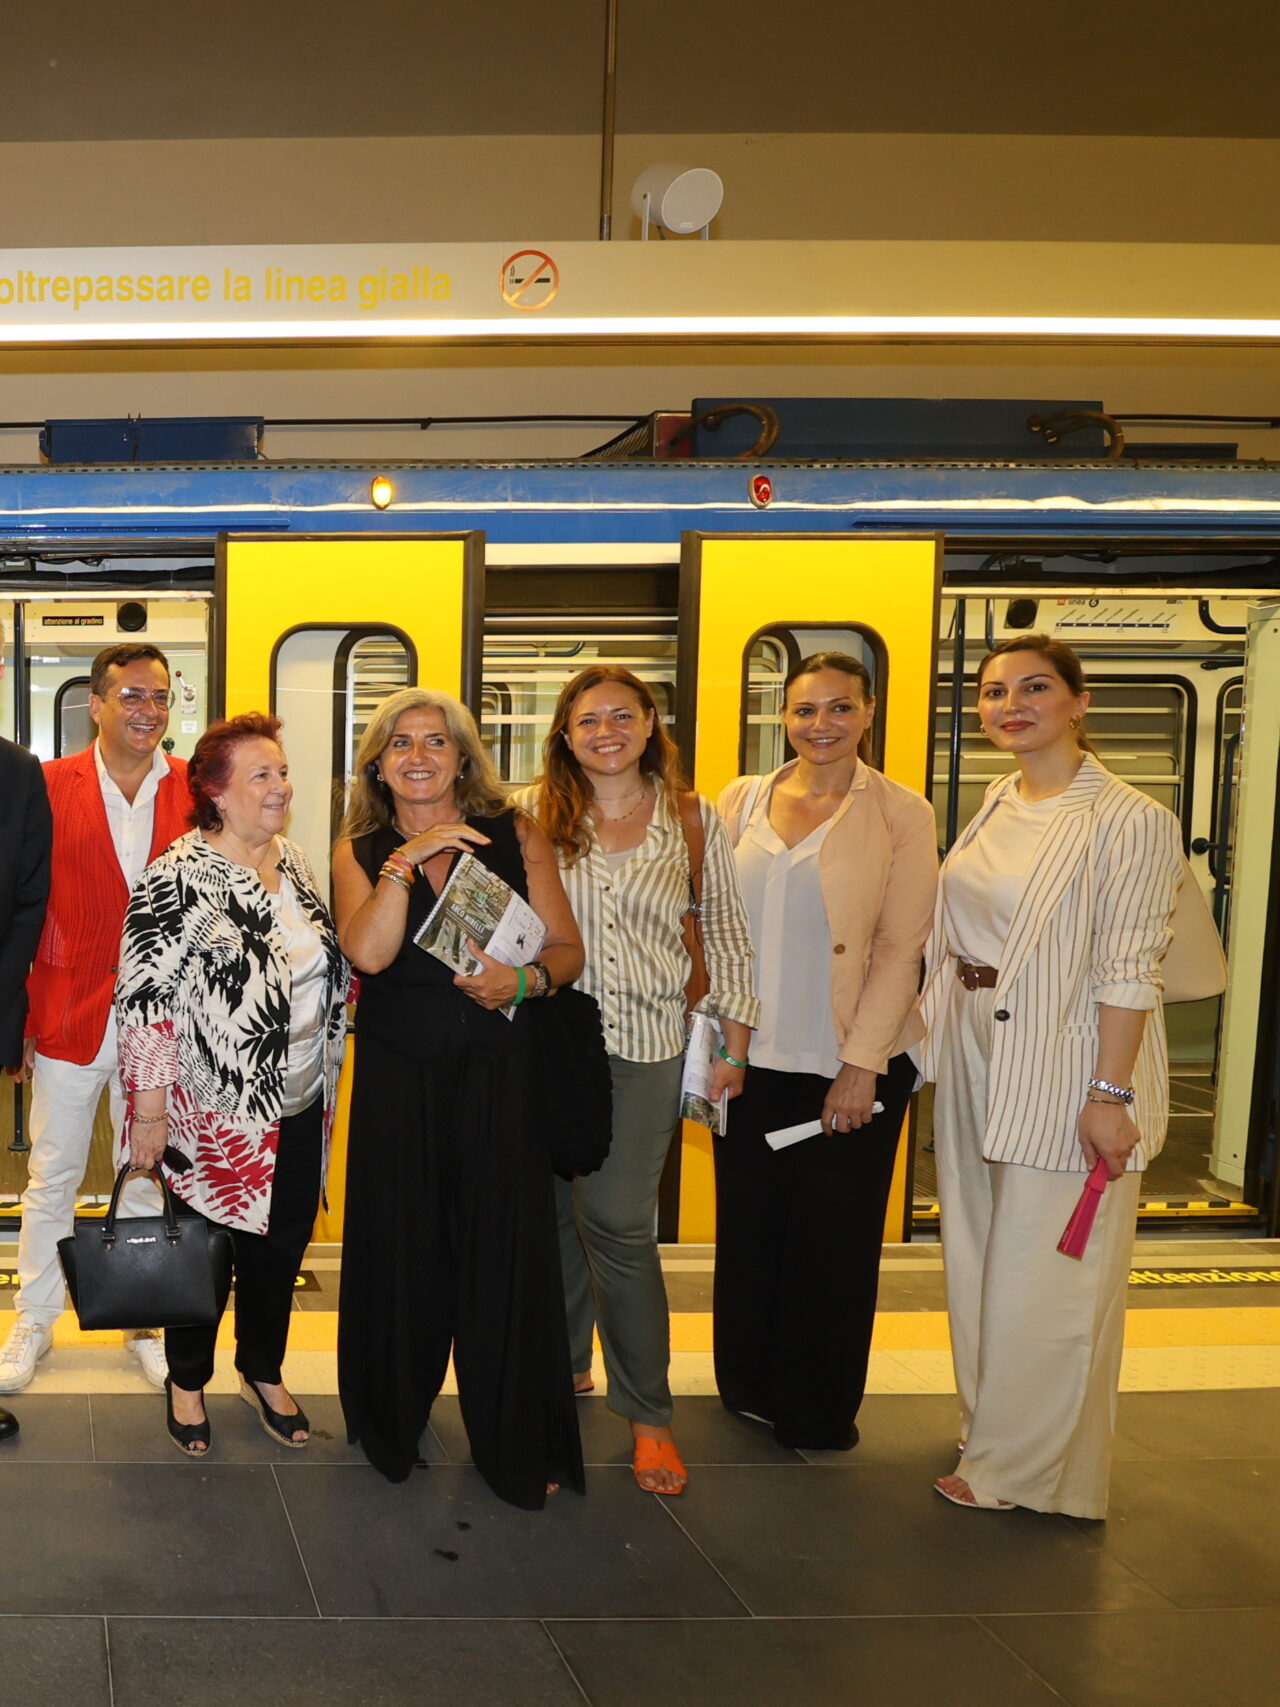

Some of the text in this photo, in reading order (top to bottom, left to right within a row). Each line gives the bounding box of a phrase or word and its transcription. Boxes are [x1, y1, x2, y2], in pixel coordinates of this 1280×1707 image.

[223, 266, 252, 302] la
[264, 266, 348, 302] linea
[356, 264, 453, 311] gialla
